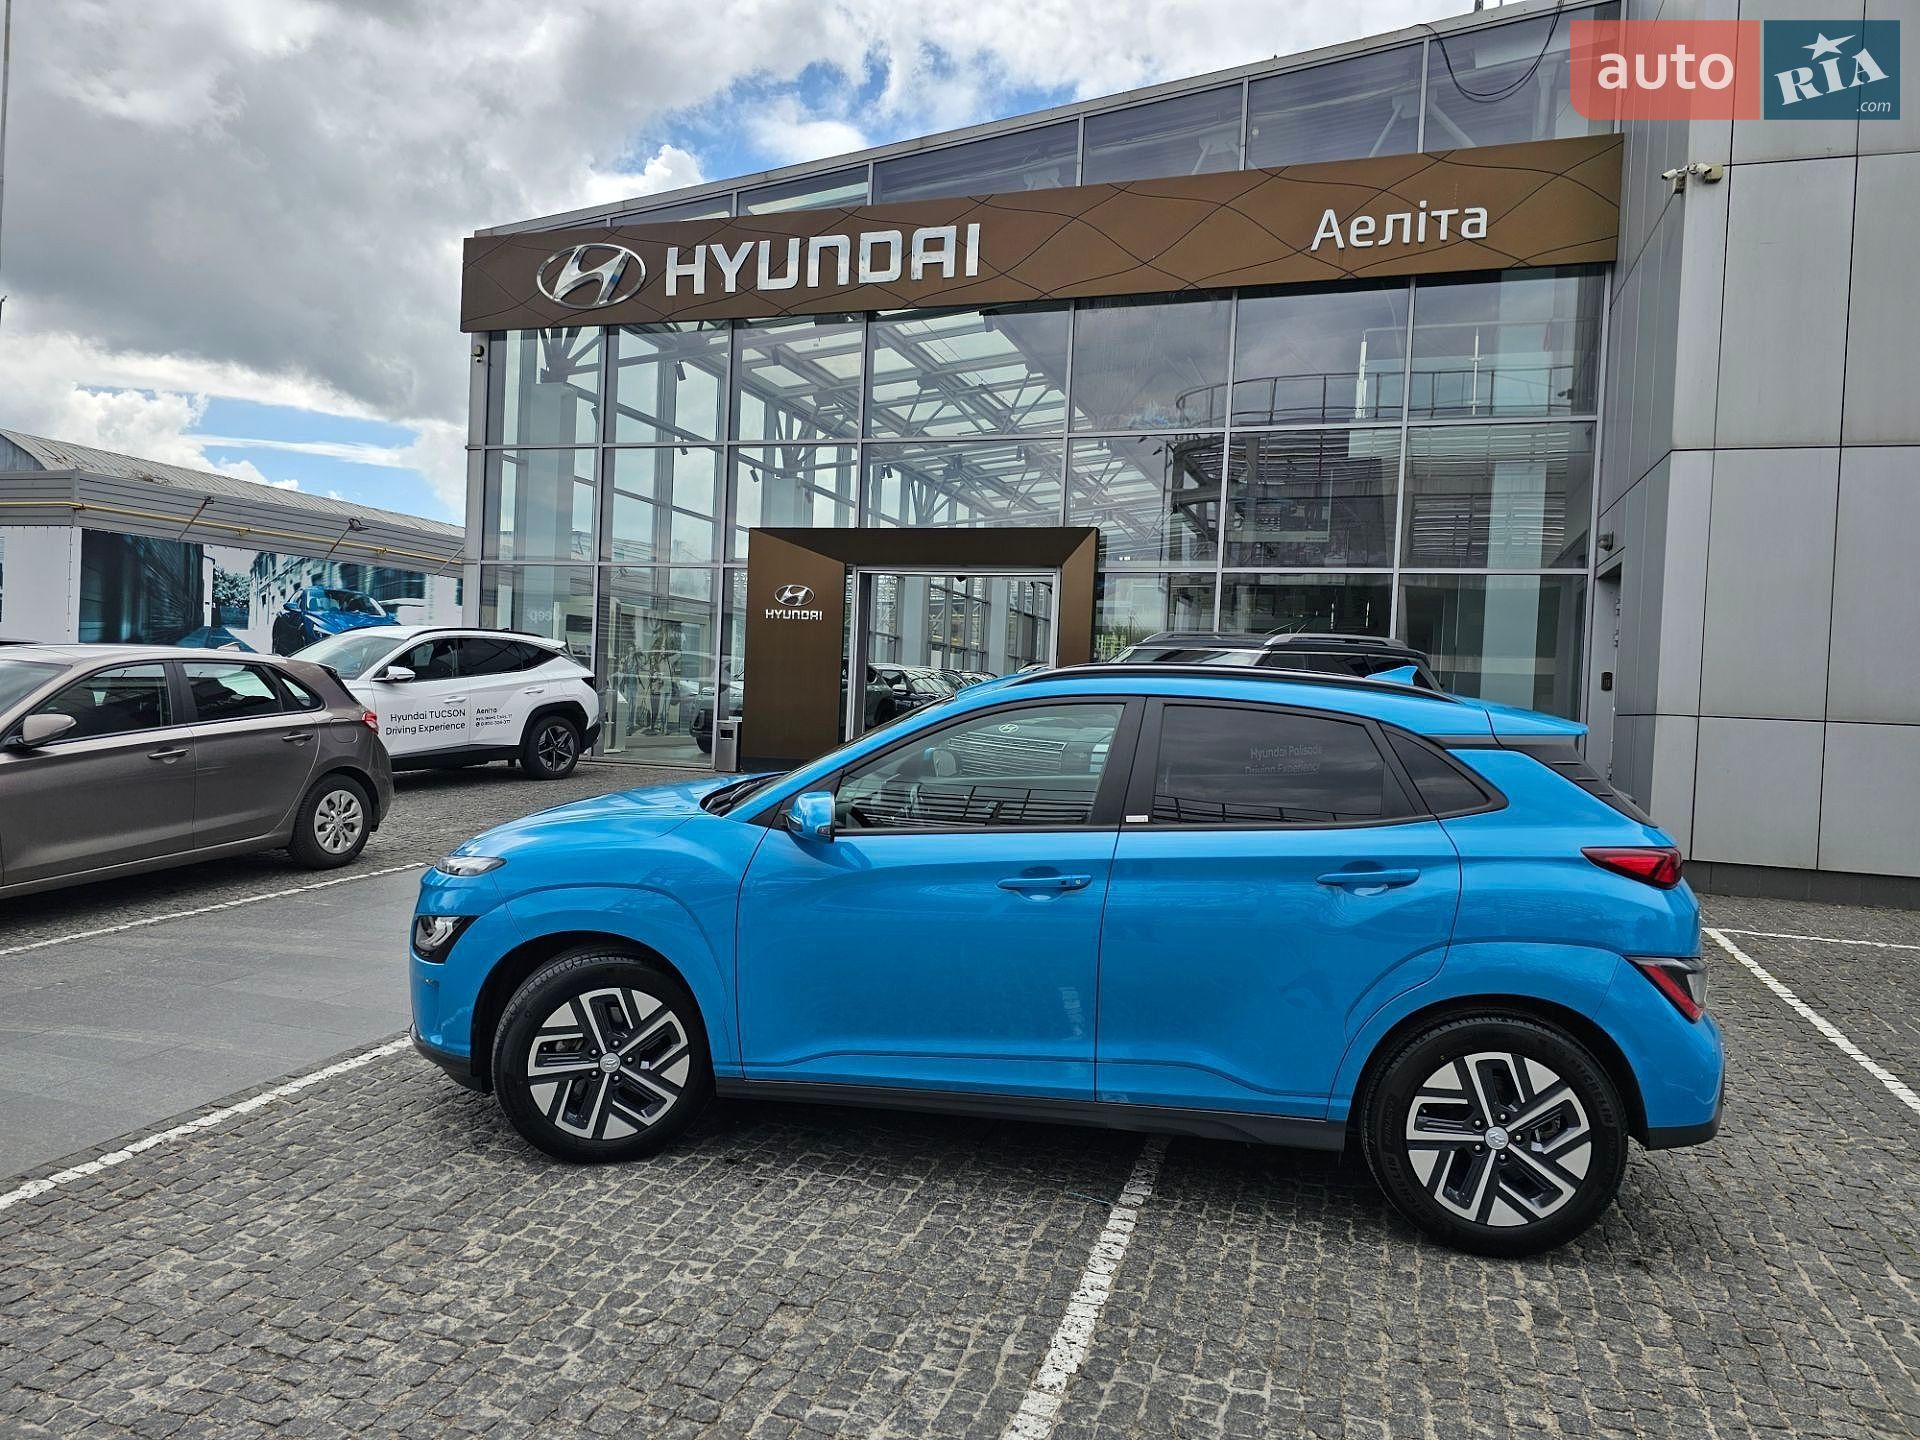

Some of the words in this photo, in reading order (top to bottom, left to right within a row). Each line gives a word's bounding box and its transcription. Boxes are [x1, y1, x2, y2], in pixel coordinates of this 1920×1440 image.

[1310, 200, 1489, 254] Аеліта
[664, 221, 981, 298] HYUNDAI
[765, 608, 823, 621] HYUNDAI
[390, 709, 427, 722] Hyundai
[429, 708, 466, 720] TUCSON
[386, 724, 417, 736] Driving
[418, 721, 466, 733] Experience
